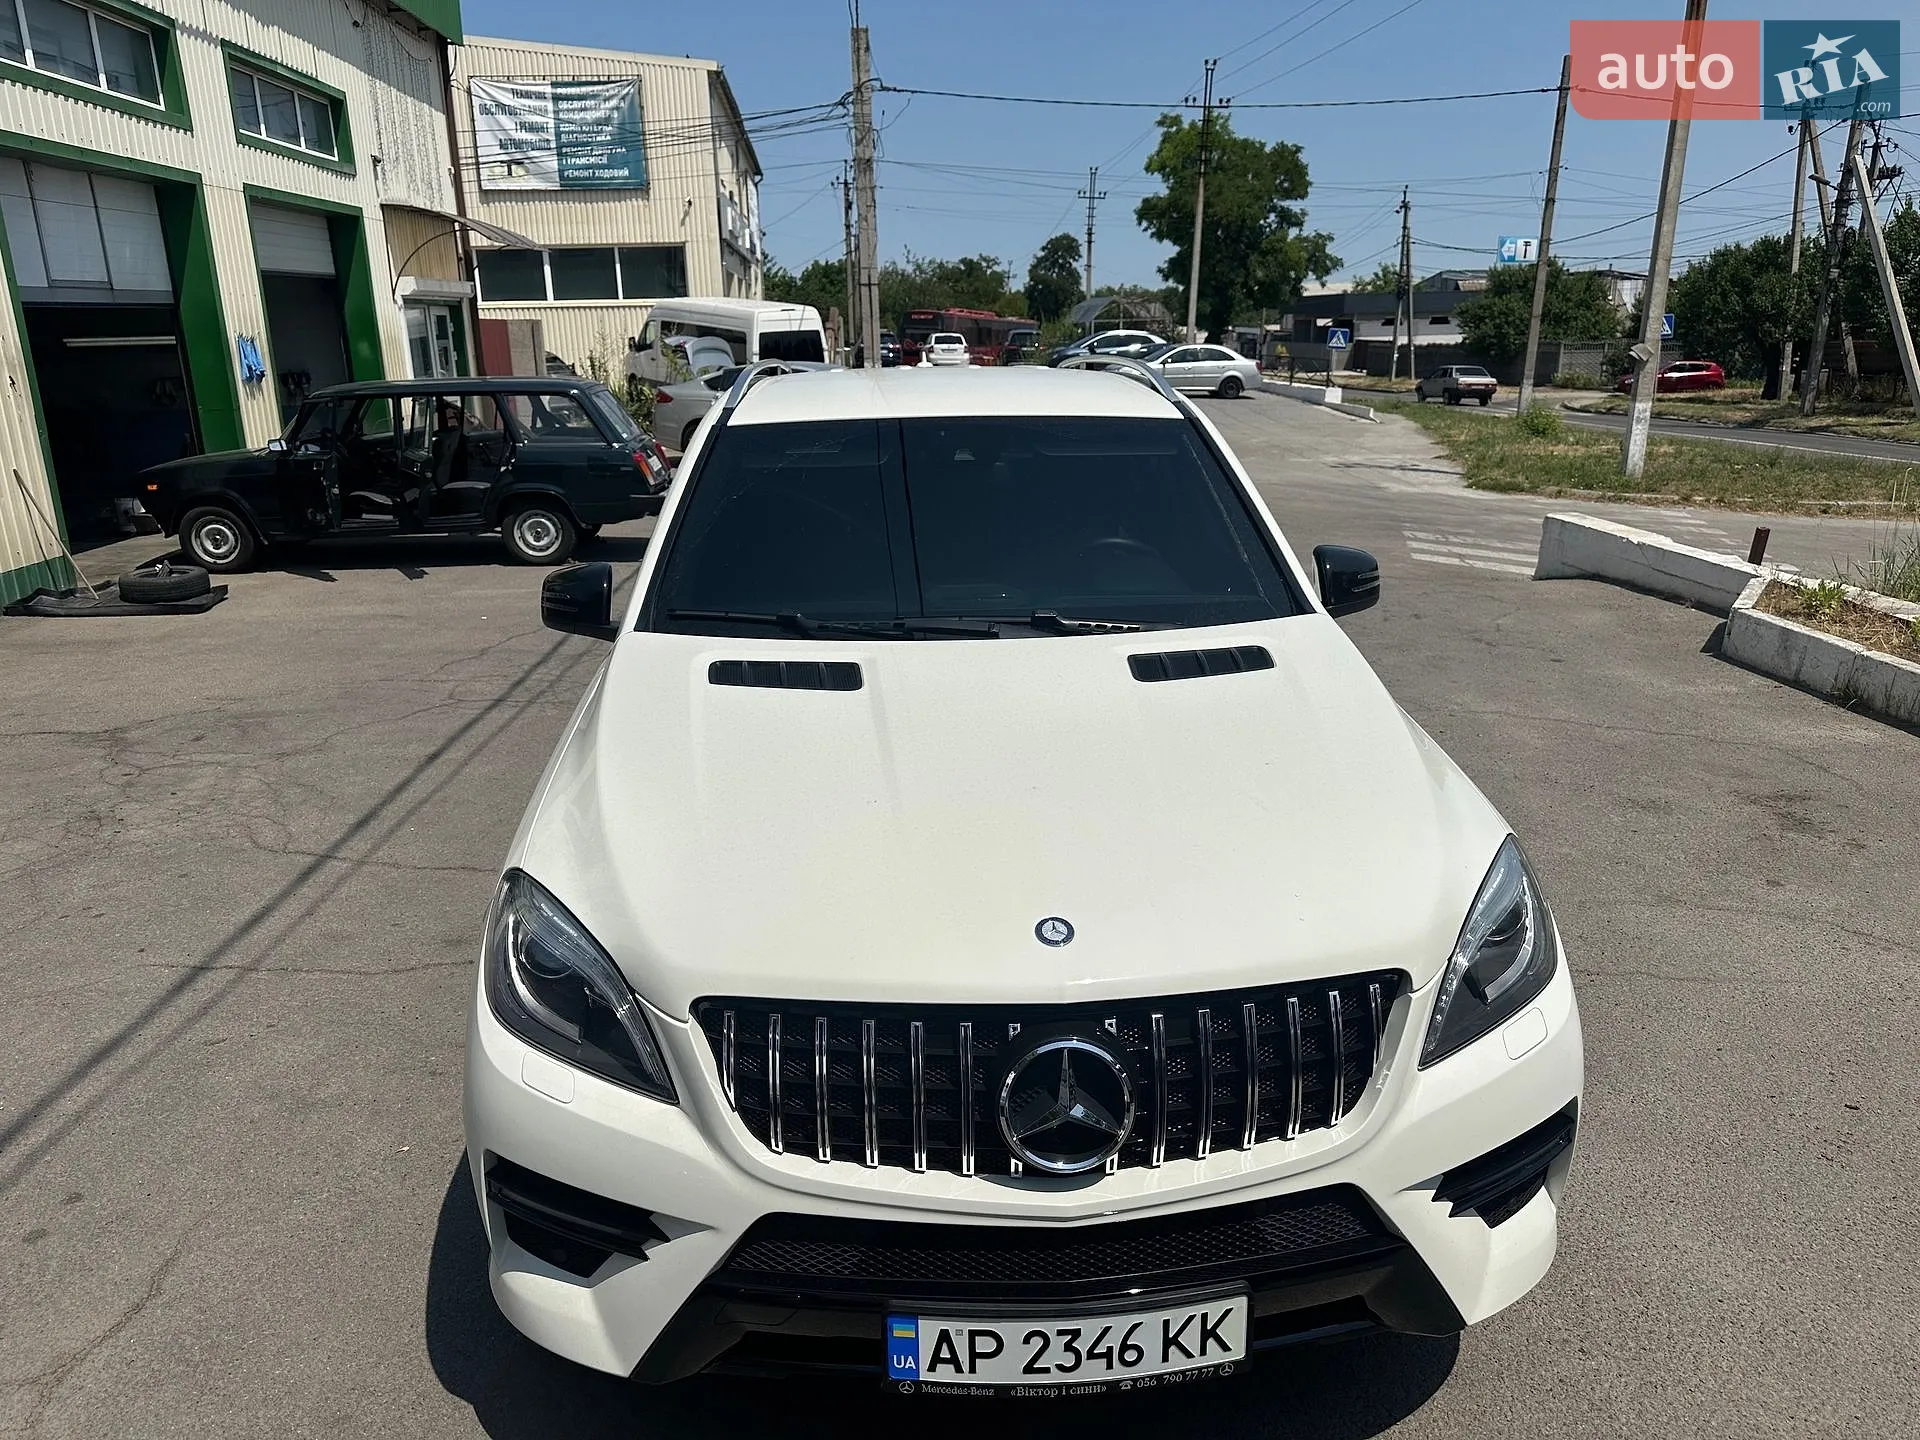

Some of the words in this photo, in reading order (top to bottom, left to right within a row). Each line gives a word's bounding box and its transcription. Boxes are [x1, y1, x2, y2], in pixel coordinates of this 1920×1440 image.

[519, 121, 550, 133] РЕМОНТ
[564, 169, 593, 178] РЕМОНТ
[594, 166, 630, 178] ХОДОВИЙ
[926, 1327, 1005, 1375] AP
[1021, 1321, 1146, 1376] 2346
[1161, 1306, 1236, 1363] KK
[893, 1355, 917, 1369] UA
[1137, 1378, 1157, 1388] 056
[1163, 1373, 1183, 1384] 790
[1186, 1370, 1199, 1380] 77
[1202, 1367, 1214, 1378] 77
[921, 1383, 995, 1396] Mercedes-Benz
